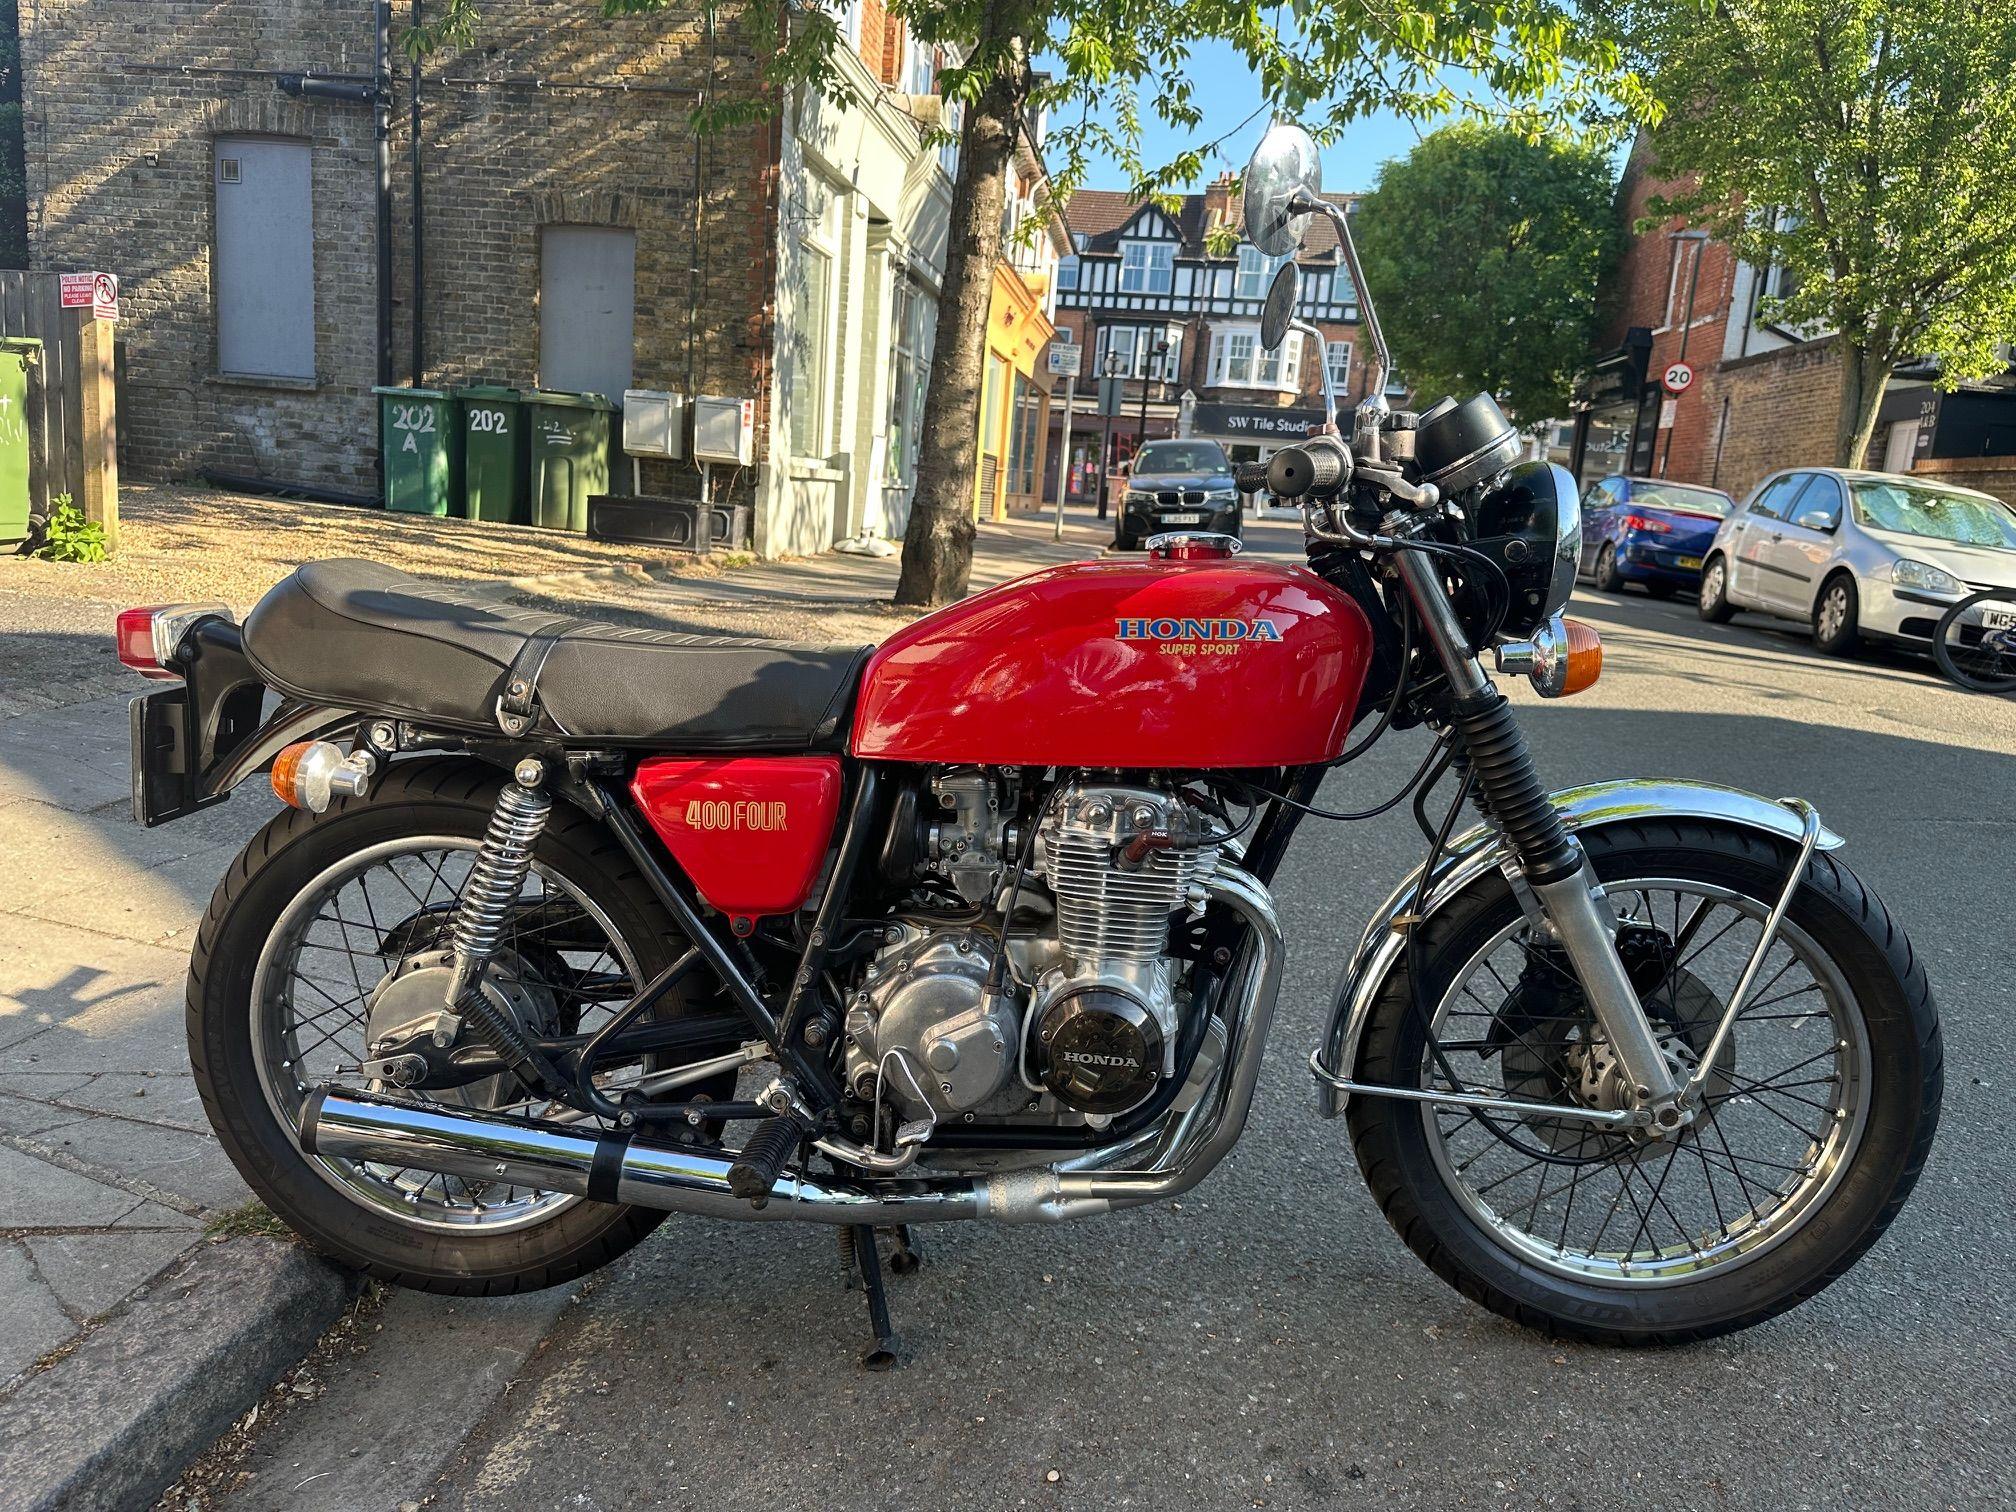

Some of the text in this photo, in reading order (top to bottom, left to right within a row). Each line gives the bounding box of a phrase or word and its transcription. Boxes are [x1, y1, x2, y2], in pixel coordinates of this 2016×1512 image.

[1668, 370, 1690, 384] 20
[392, 404, 436, 433] 202
[469, 409, 508, 435] 202
[1228, 416, 1250, 429] SW
[1252, 417, 1275, 431] Tile
[402, 432, 418, 454] A
[1115, 617, 1283, 642] HONDA
[1159, 643, 1240, 656] SUPER SPORT
[685, 800, 788, 831] 400 FOUR
[1063, 1051, 1140, 1068] HONDA
